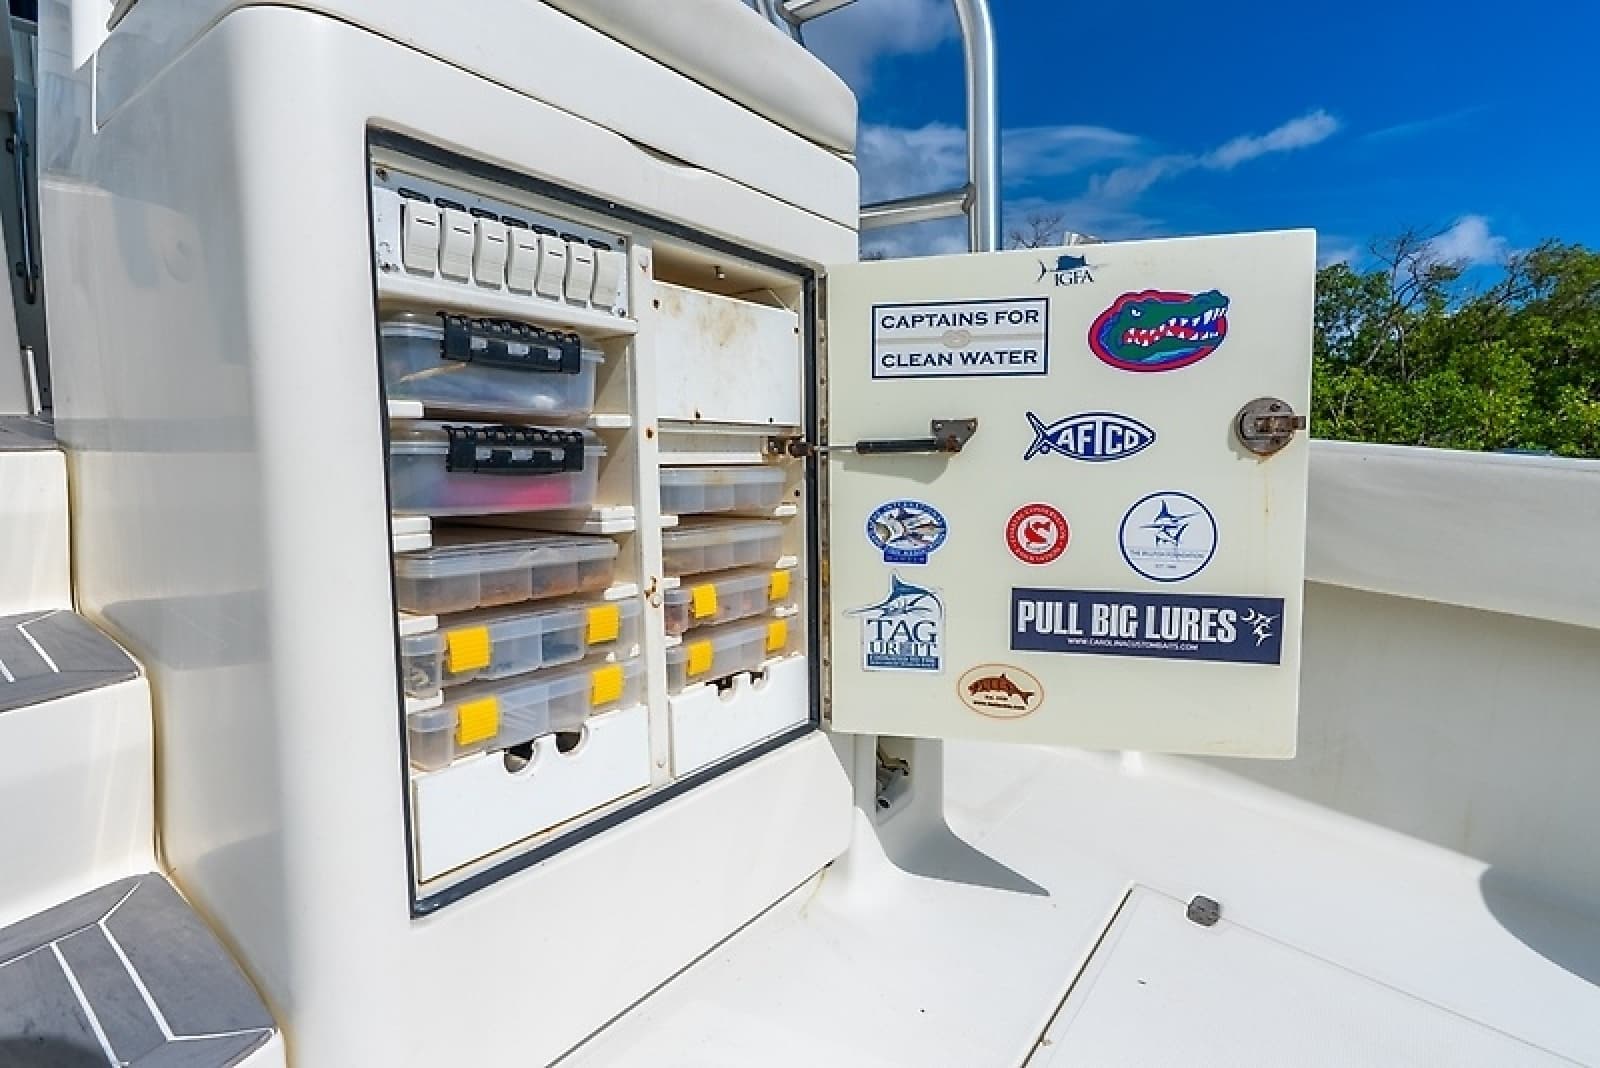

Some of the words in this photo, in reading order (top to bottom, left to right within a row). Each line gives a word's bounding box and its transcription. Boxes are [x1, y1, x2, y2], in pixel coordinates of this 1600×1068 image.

[1055, 270, 1094, 286] IGFA
[881, 311, 989, 329] CAPTAINS
[995, 309, 1039, 325] FOR
[881, 351, 953, 368] CLEAN
[959, 350, 1038, 365] WATER
[1057, 420, 1139, 455] AFTCO
[867, 619, 937, 643] TAG
[1017, 600, 1083, 635] PULL
[1091, 603, 1139, 638] BIG
[1145, 606, 1237, 643] LURES
